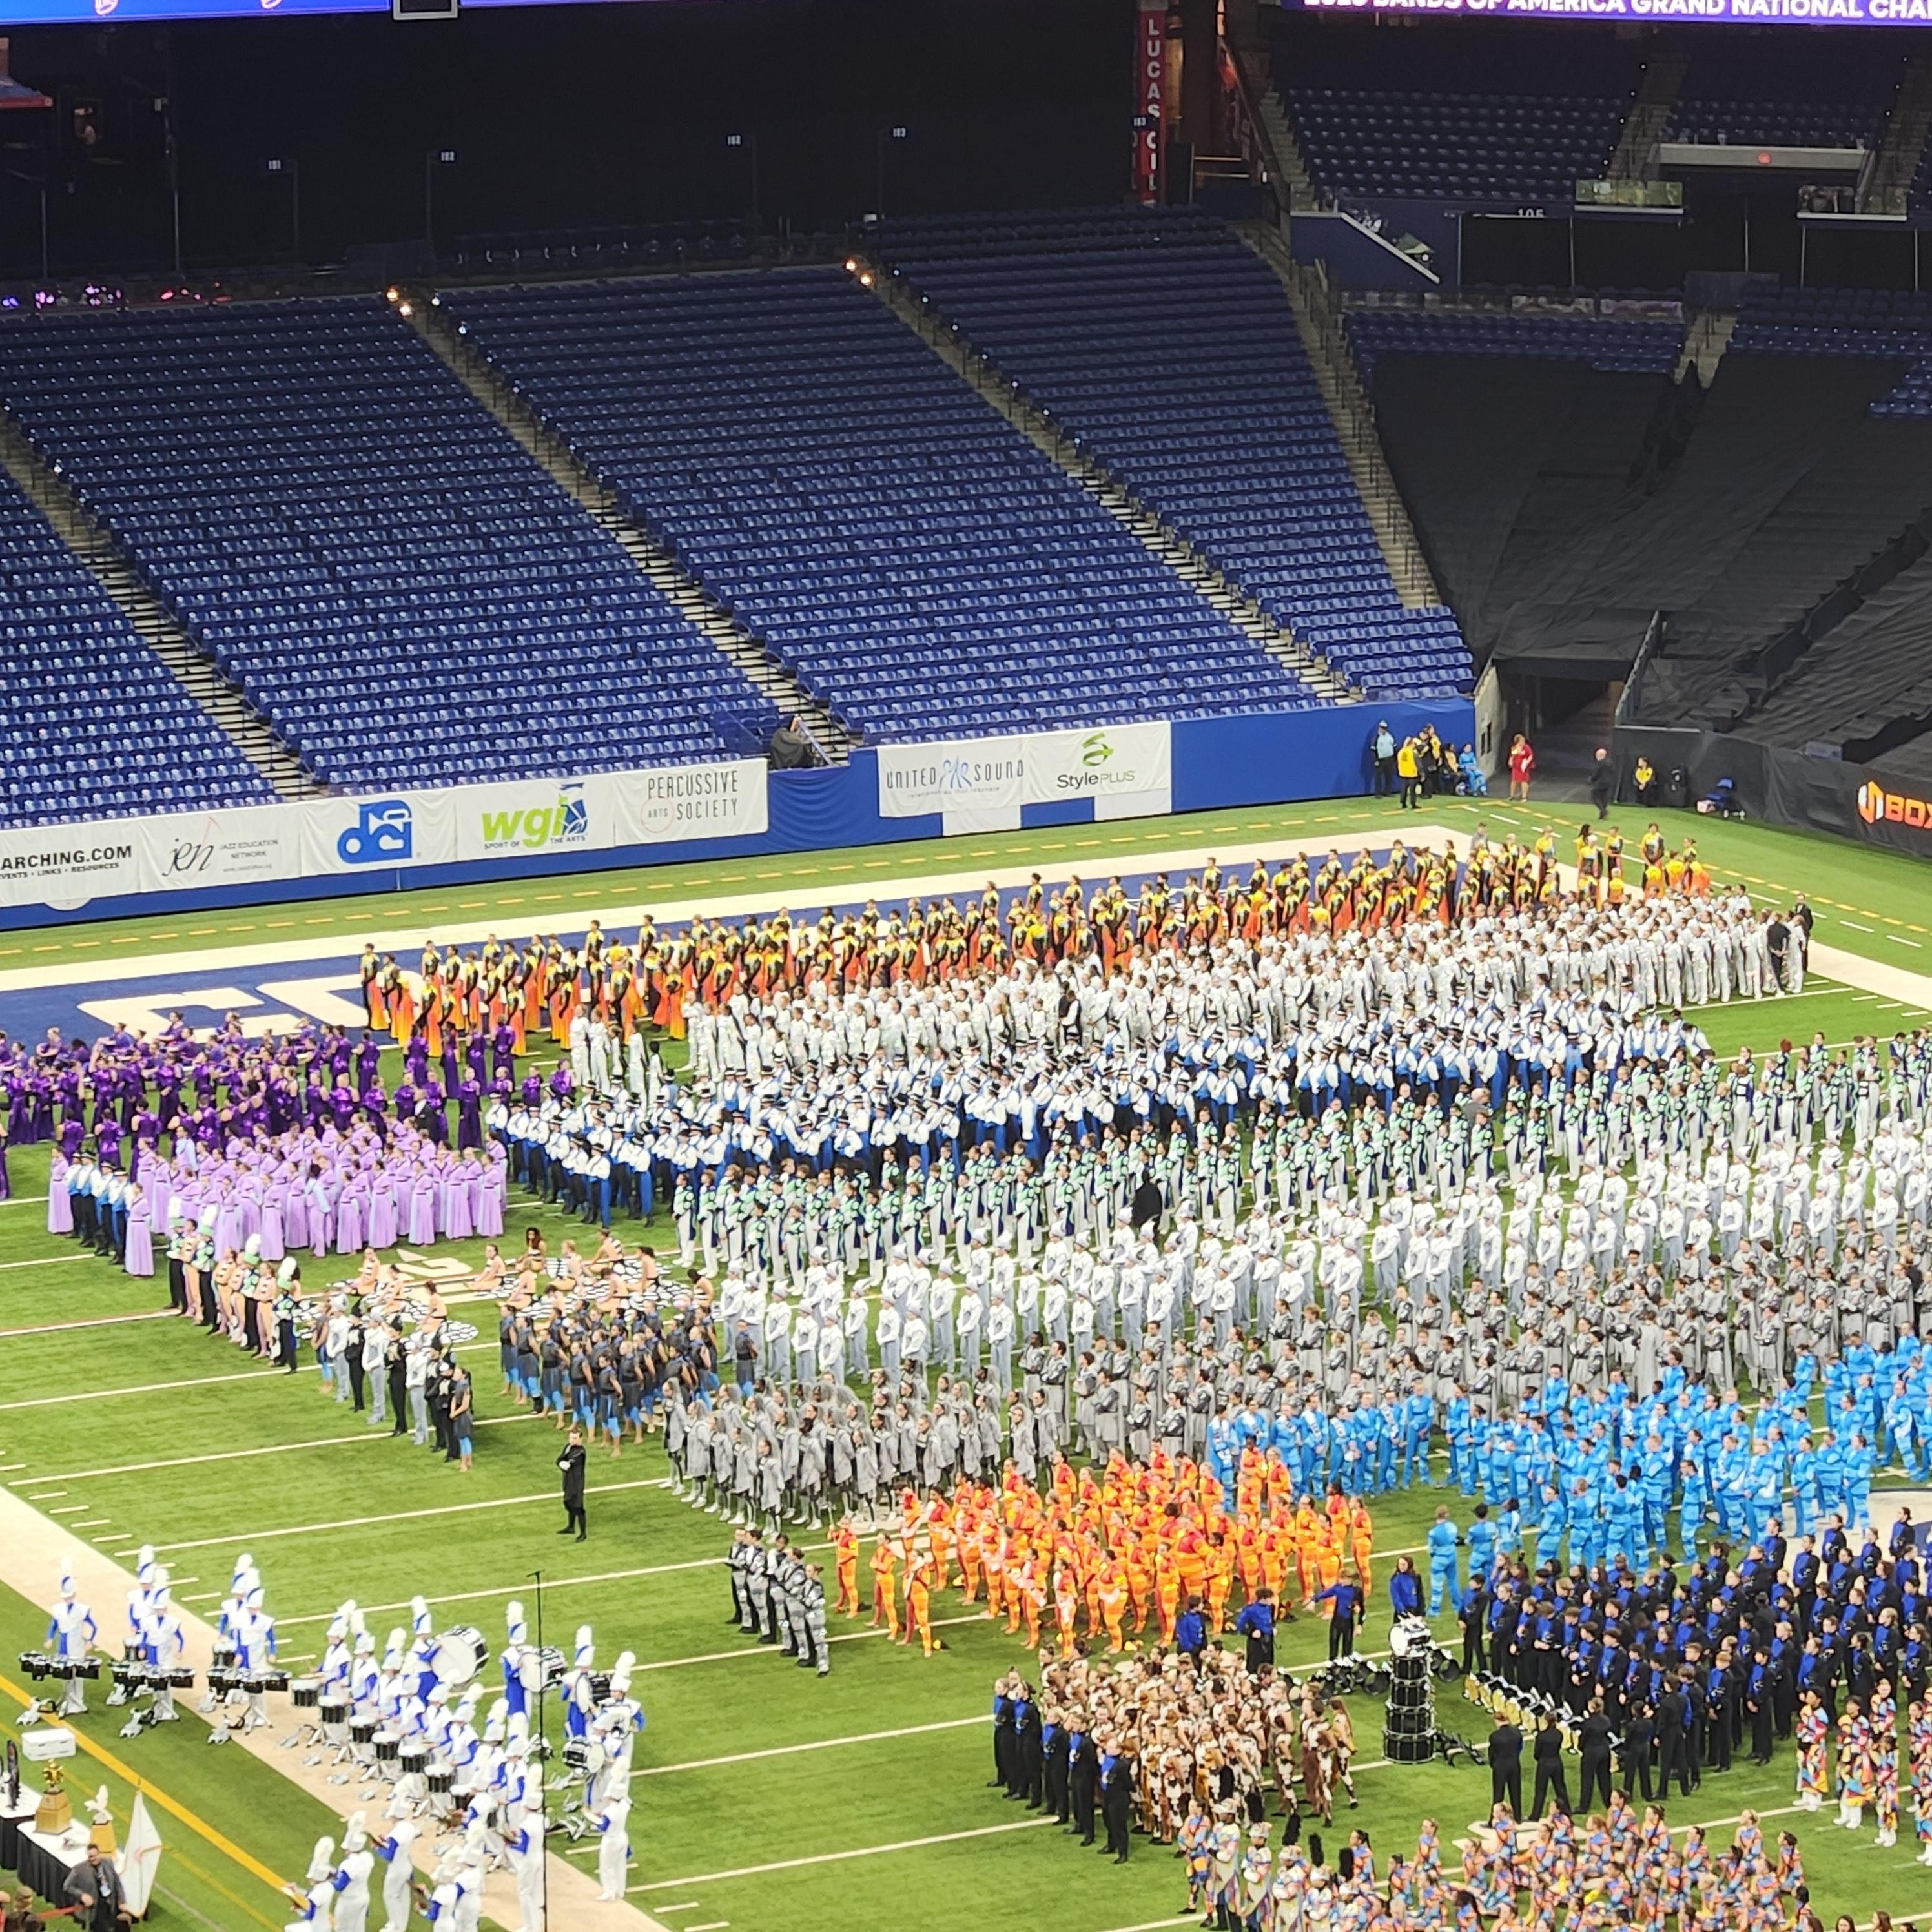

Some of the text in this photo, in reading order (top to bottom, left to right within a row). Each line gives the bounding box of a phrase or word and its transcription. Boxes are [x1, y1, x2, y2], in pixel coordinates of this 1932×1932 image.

[1631, 0, 1725, 14] GRAND
[1731, 0, 1865, 17] NATIONAL
[1868, 0, 1932, 20] CHA
[1146, 19, 1161, 118] LUCAS
[648, 770, 738, 799] PERCUSSIVE
[887, 759, 1023, 789] UNITED SOUND
[648, 808, 668, 818] ARTS
[677, 798, 737, 821] SOCIETY
[238, 839, 278, 848] EDUCATION
[484, 841, 508, 850] SPORT
[1, 845, 132, 870] ARCHING.COM
[161, 838, 214, 877] jen
[231, 850, 267, 859] NETWORK
[0, 862, 119, 879] VENTS LINKS RESOURCES
